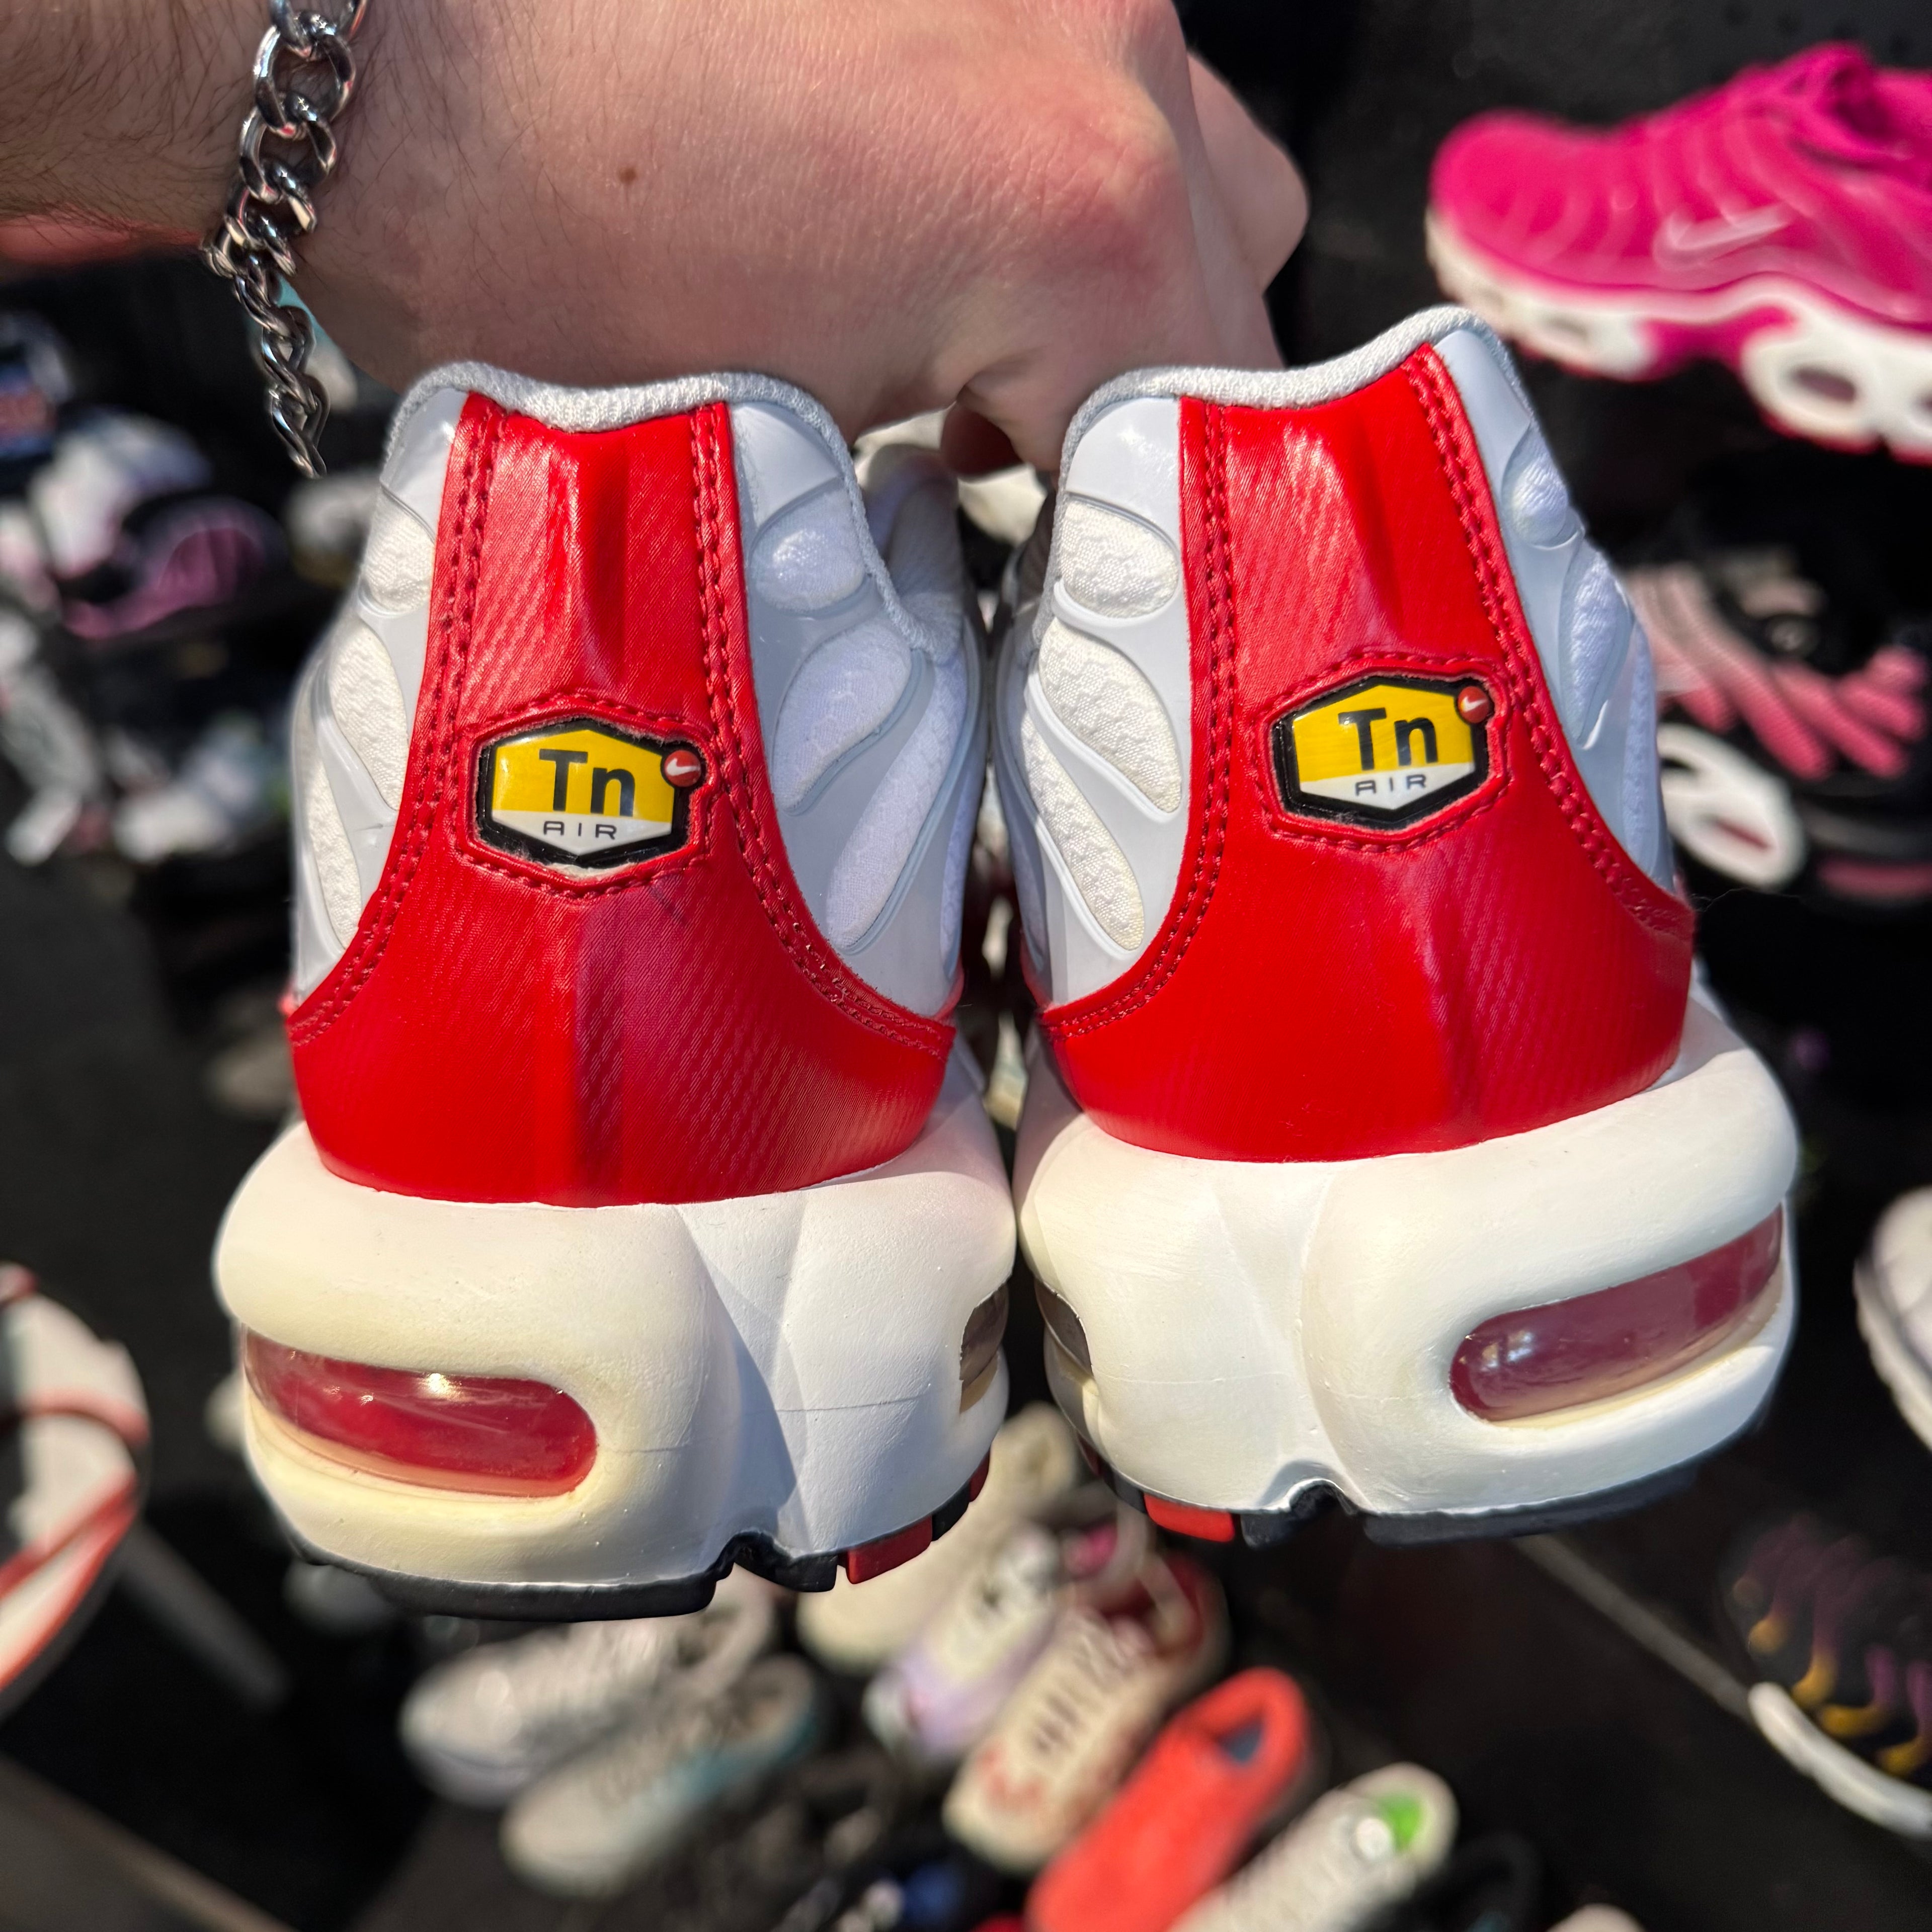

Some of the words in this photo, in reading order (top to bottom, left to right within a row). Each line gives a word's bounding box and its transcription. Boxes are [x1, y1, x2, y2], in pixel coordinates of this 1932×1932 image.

[1338, 707, 1438, 771] Tn
[539, 749, 635, 817] Tn
[1355, 774, 1426, 796] AIR
[543, 821, 617, 840] AIR
